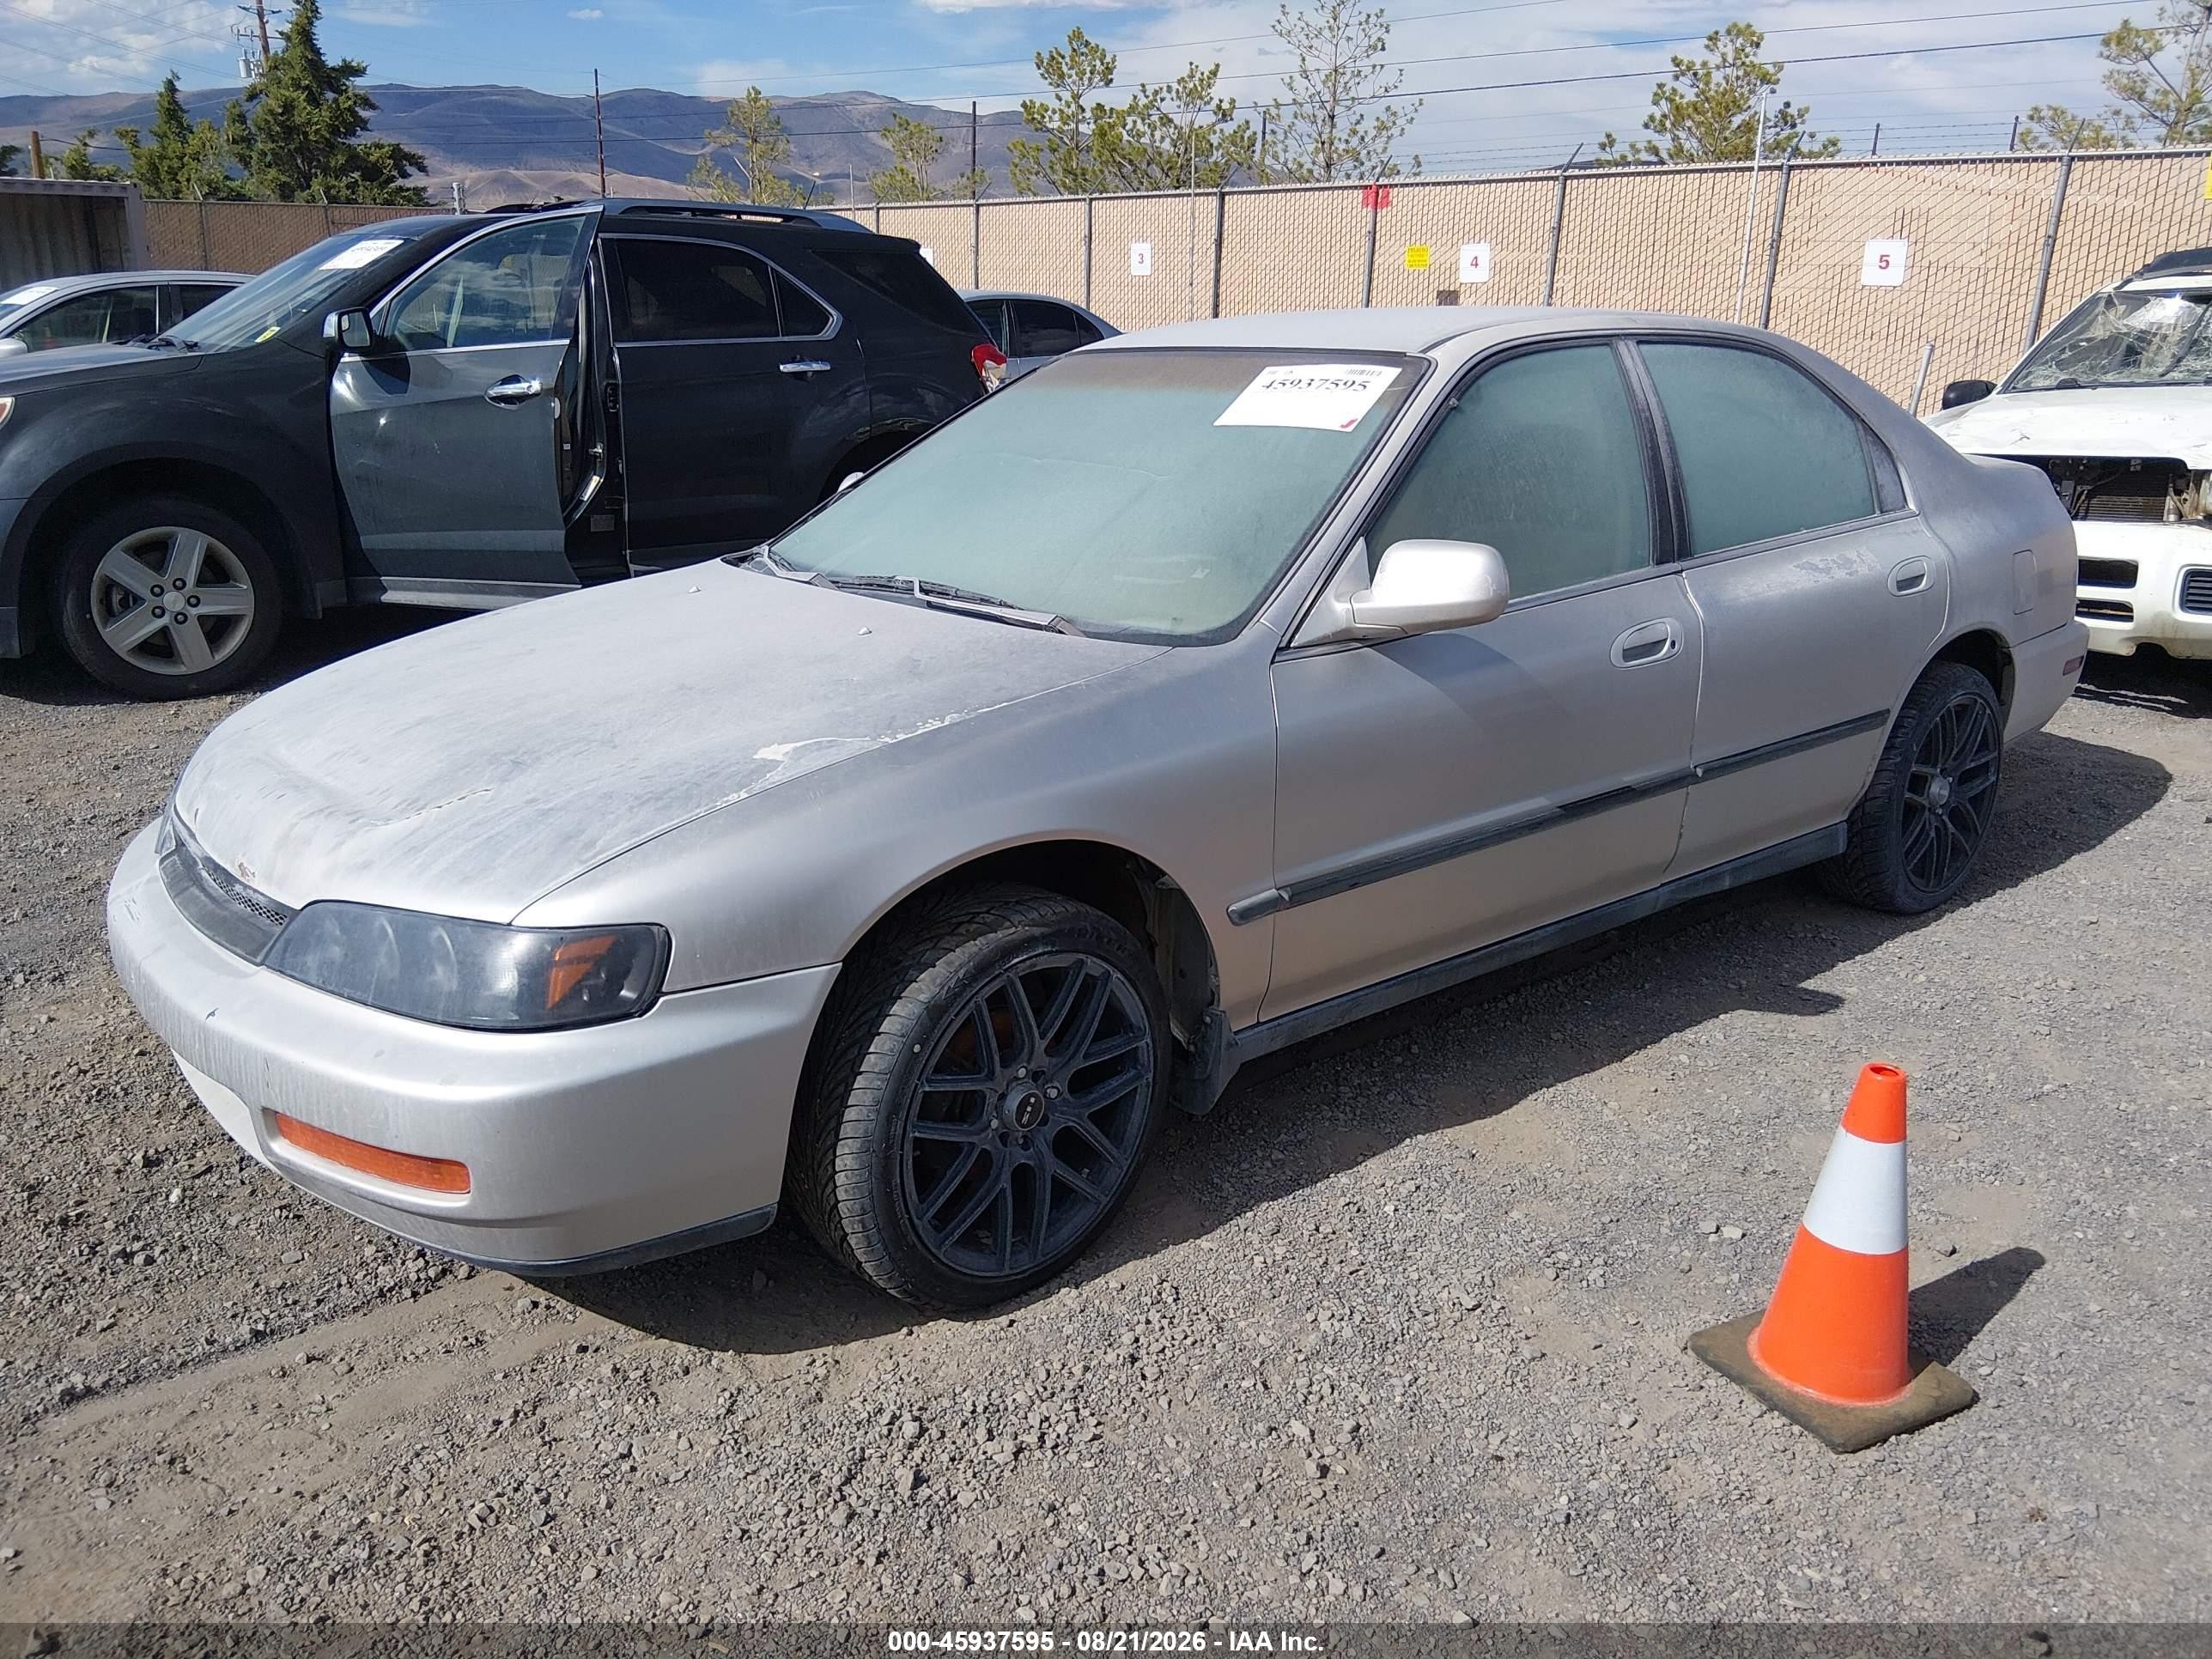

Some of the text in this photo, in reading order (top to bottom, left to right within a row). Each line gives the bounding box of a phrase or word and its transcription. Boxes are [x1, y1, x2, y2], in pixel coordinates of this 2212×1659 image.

[1138, 252, 1144, 264] 3
[1470, 255, 1479, 269] 4
[1878, 254, 1890, 270] 5
[1261, 378, 1371, 392] 45937595
